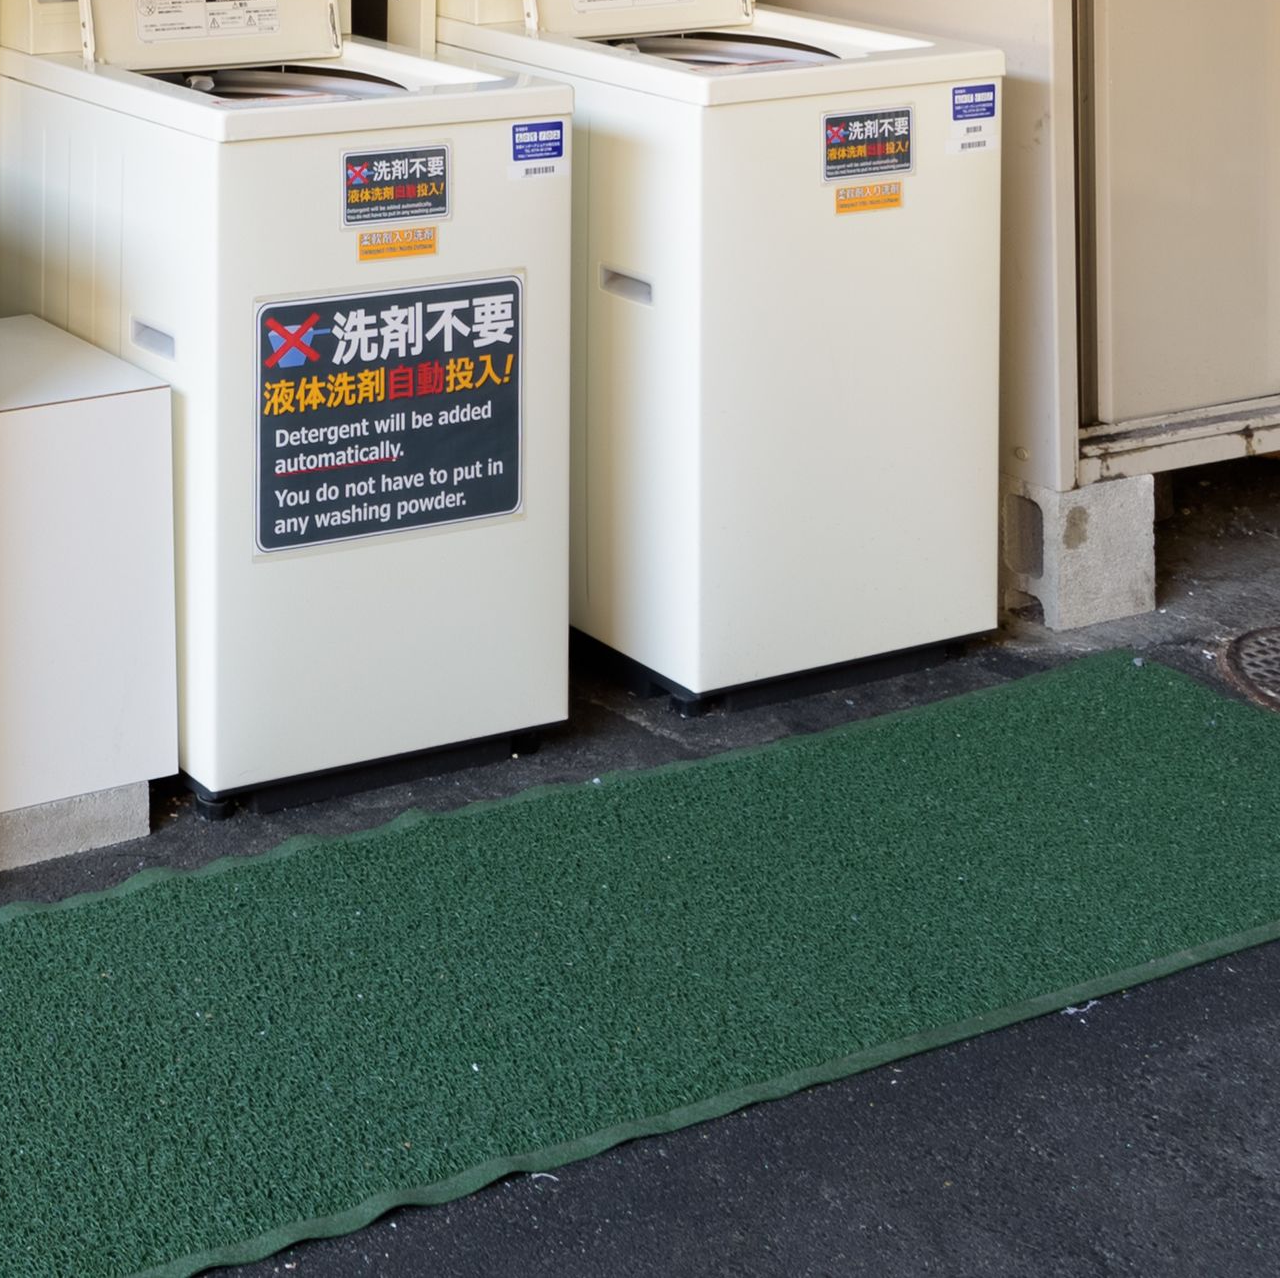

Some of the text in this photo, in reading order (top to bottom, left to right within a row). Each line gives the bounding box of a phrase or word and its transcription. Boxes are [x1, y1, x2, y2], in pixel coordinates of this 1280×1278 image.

[848, 116, 909, 140] 洗剤不要
[373, 156, 444, 181] 洗剤不要
[332, 294, 515, 365] 洗剤不要
[263, 354, 514, 415] 液体洗剤自動投入!
[275, 401, 491, 448] Detergent will be added
[275, 441, 404, 473] automatically.
[275, 458, 504, 507] You do not have to put in
[274, 491, 467, 534] any washing powder.
